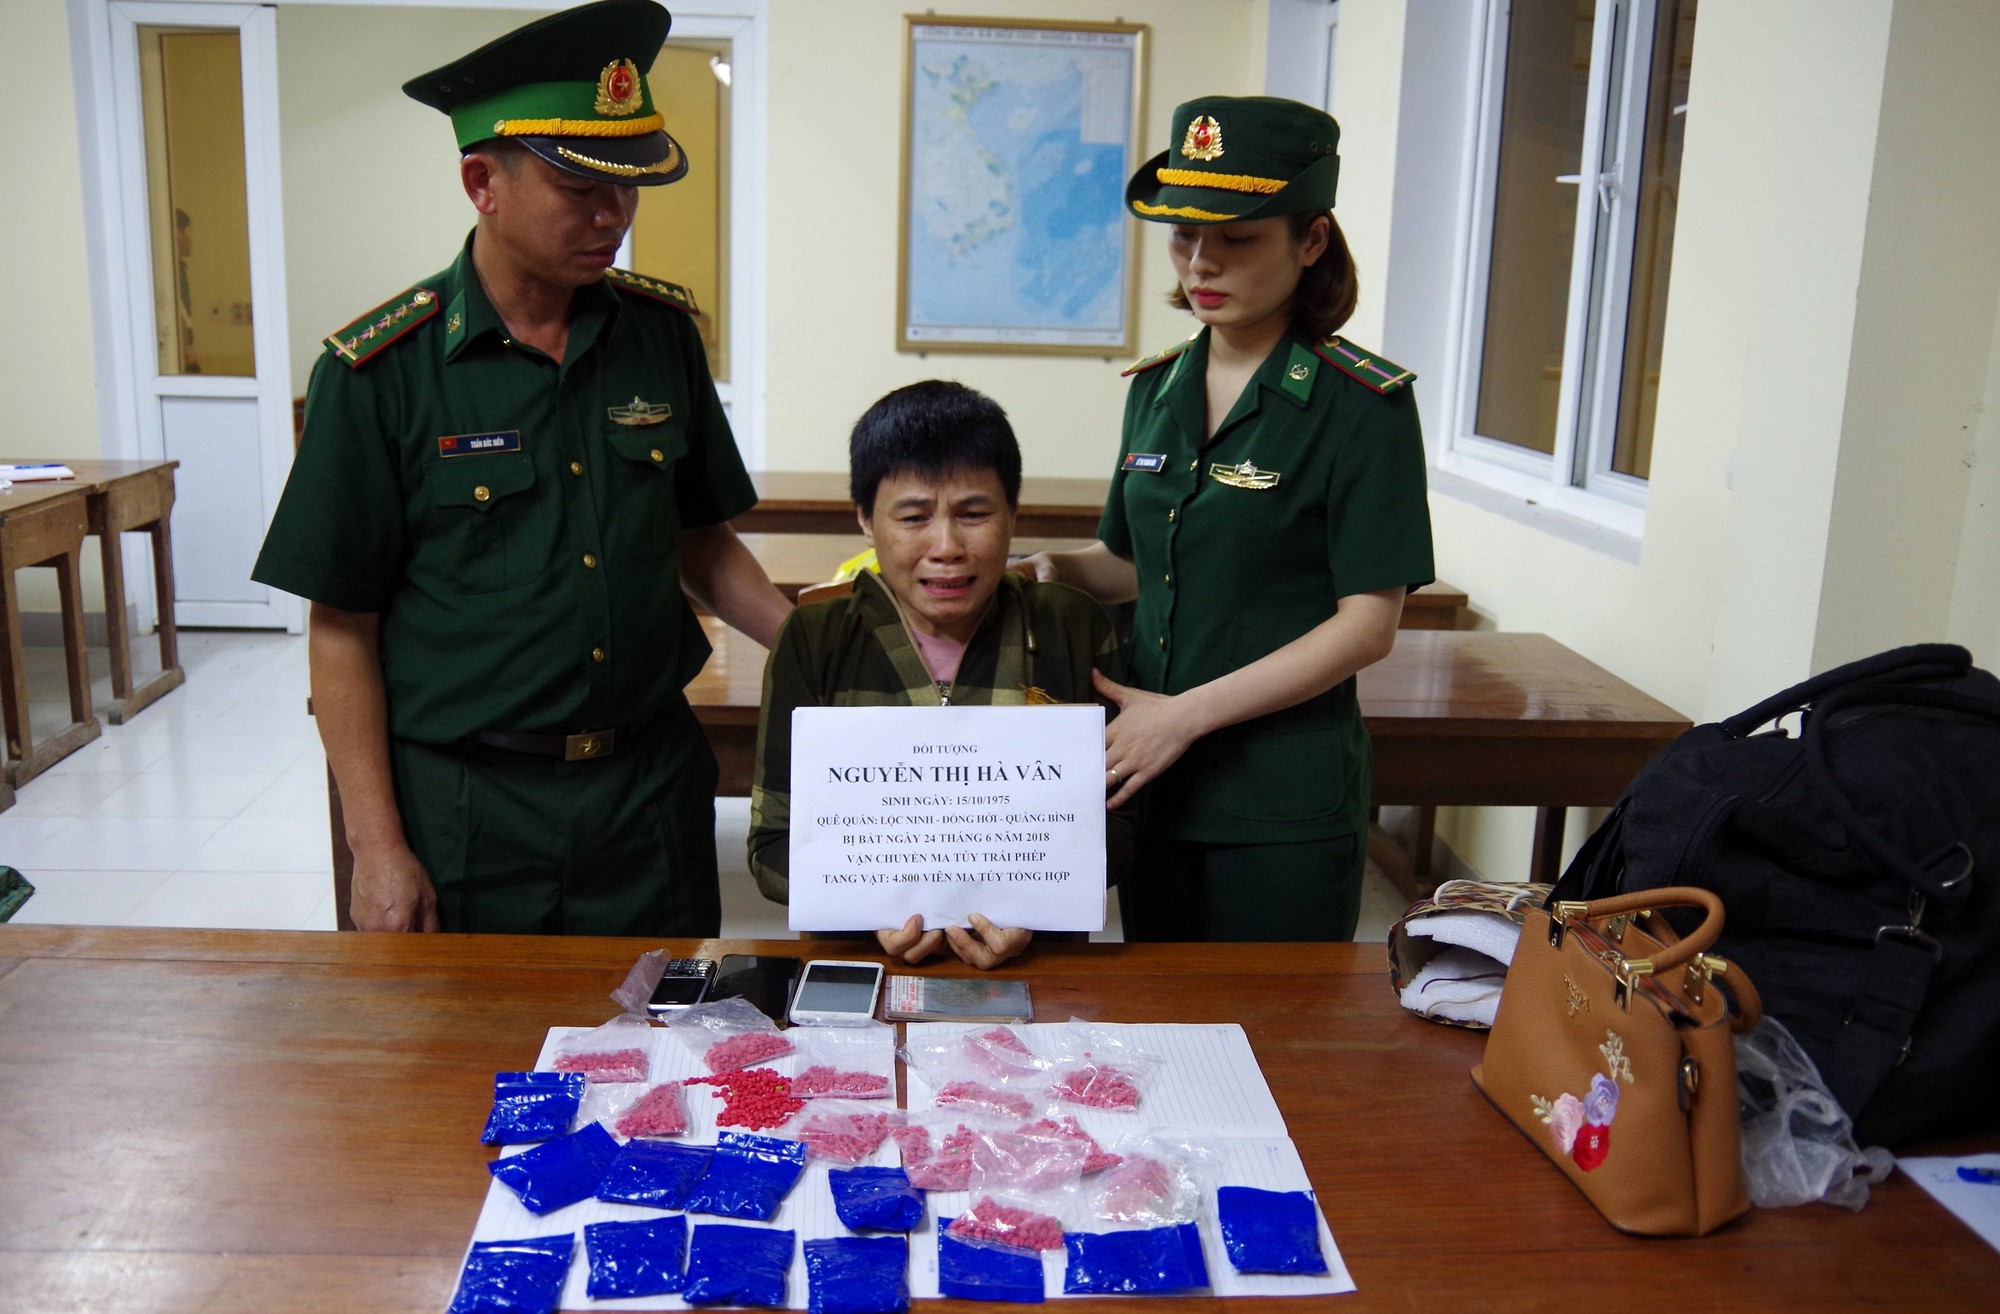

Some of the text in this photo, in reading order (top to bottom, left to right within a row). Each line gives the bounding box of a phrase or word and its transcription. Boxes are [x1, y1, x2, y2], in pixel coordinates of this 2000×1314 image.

[936, 743, 978, 756] TƯỢNG
[828, 759, 1062, 786] NGUYỄN THỊ HÀ VÂN
[881, 794, 1010, 806] SINH NGÀY: 15/10/1975
[817, 813, 840, 826] QUÊ
[842, 813, 878, 827] QUÁN:
[880, 814, 903, 827] LỘC
[906, 815, 933, 825] NINH
[1005, 811, 1045, 826] QUẢNG
[1048, 811, 1075, 823] BÌNH
[843, 834, 855, 847] BỊ
[886, 831, 921, 844] NGÀY
[924, 833, 936, 843] 24
[939, 830, 982, 843] THÁNG
[985, 832, 992, 842] 6
[995, 830, 1022, 842] NĂM
[1026, 832, 1050, 842] 2018
[930, 852, 950, 863] MA
[953, 850, 979, 863] TÚY
[982, 849, 1011, 862] TRÁI
[1015, 849, 1046, 862] PHÉP
[822, 873, 857, 884] TANG
[892, 873, 920, 883] 4.800
[923, 870, 952, 883] VIÊN
[956, 872, 975, 883] MA
[978, 869, 1004, 882] TÚY
[1045, 870, 1071, 884] HỢP
